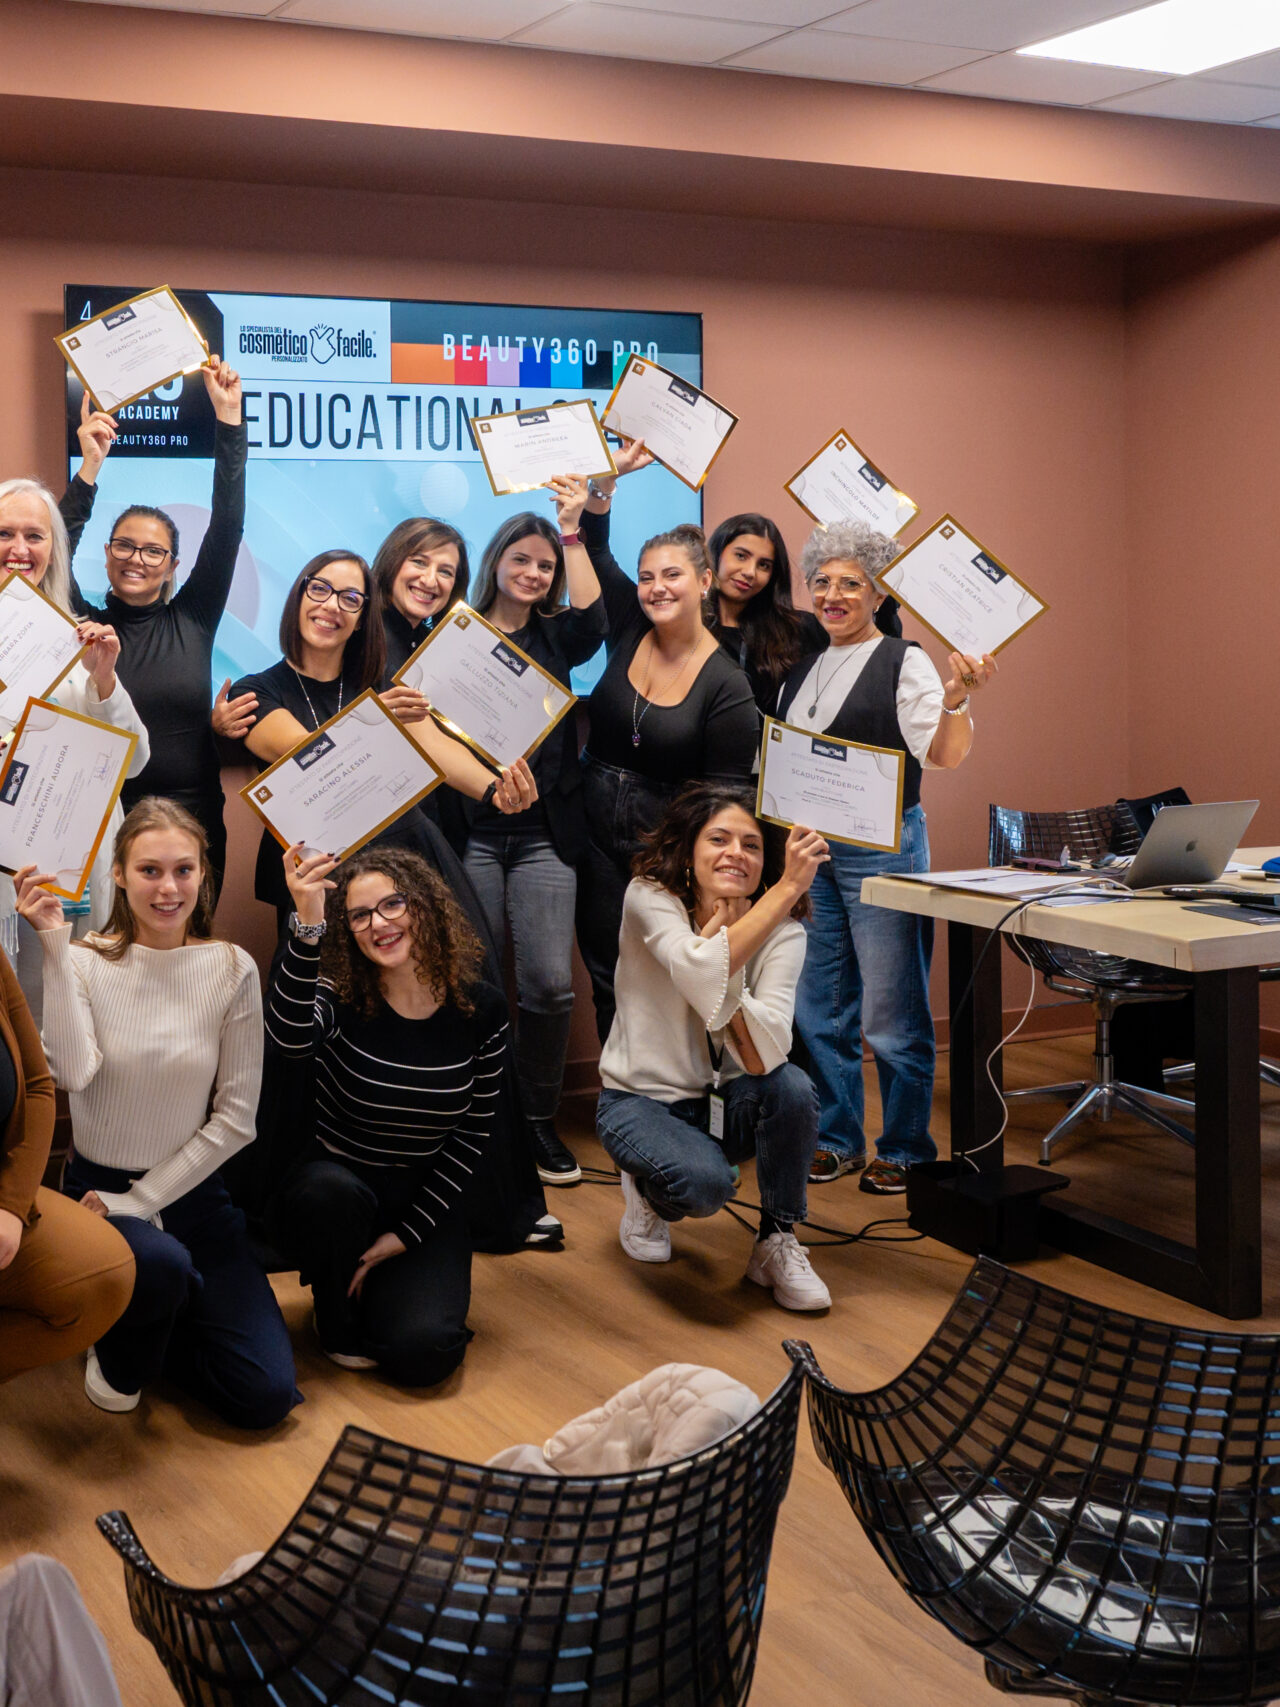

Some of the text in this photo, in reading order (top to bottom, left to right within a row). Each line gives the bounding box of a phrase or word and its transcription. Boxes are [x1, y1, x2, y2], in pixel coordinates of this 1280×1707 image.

[239, 328, 377, 358] cosmetico facile.
[442, 333, 597, 366] BEAUTY360
[118, 405, 180, 420] ACADEMY
[242, 391, 521, 451] EDUCATION
[170, 435, 189, 446] PRO
[302, 775, 342, 807] SARACINO
[341, 751, 372, 777] ALESSIA
[792, 768, 865, 793] SCADUTO FEDERICA
[25, 782, 54, 848] FRANCESCHINI
[50, 744, 69, 781] AURORA
